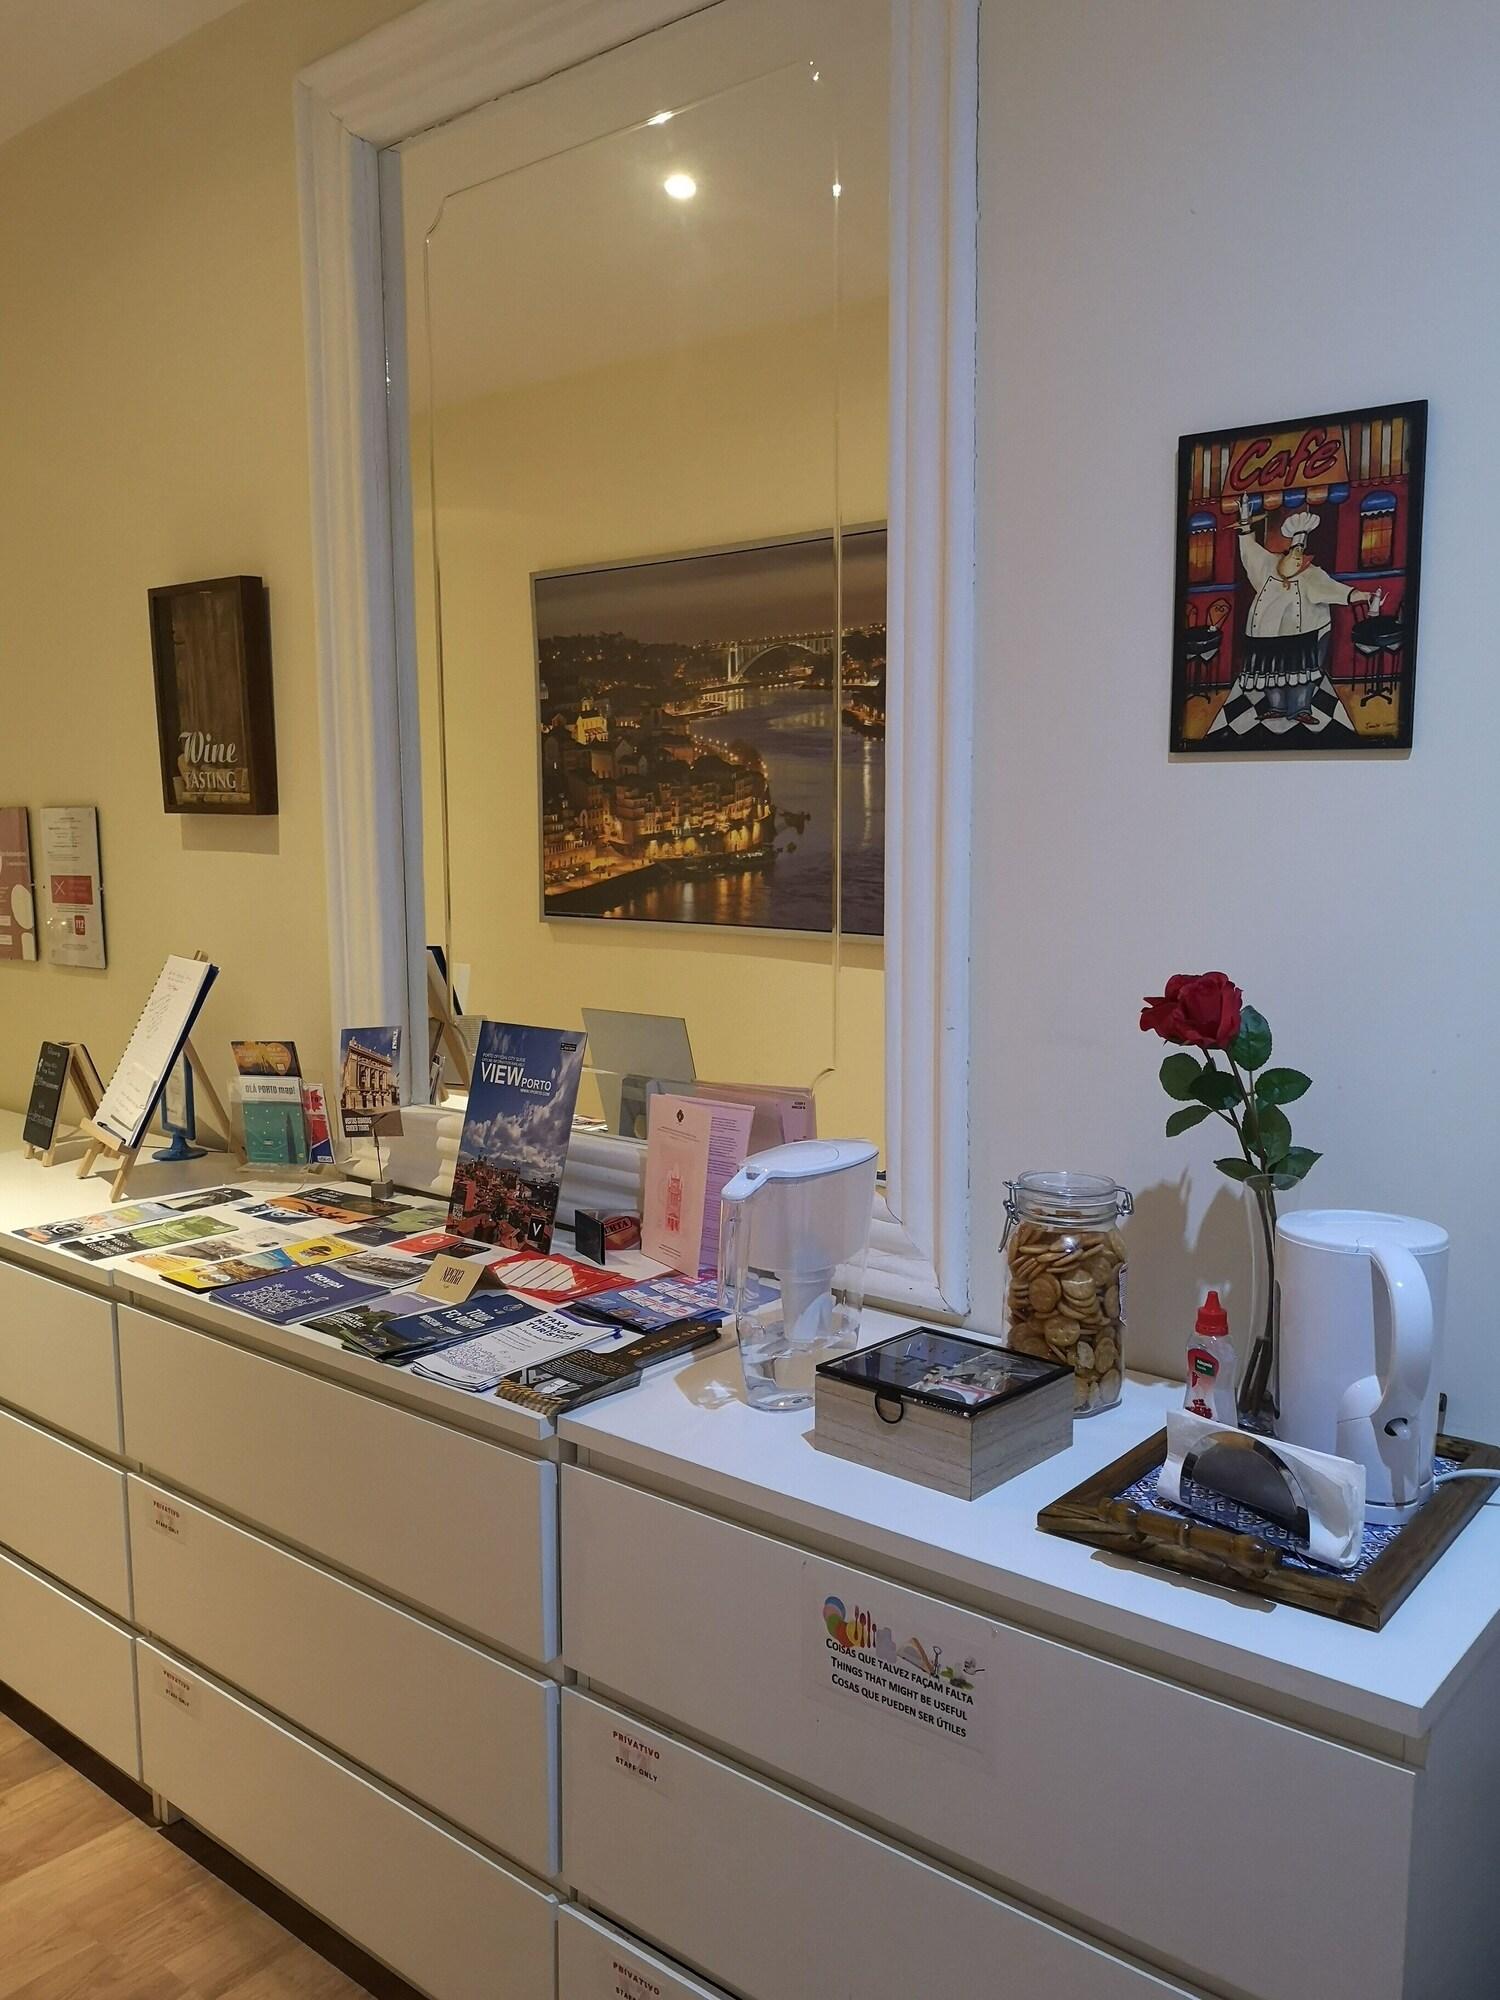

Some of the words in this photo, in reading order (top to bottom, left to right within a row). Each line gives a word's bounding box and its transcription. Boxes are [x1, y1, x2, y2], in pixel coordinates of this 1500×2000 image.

[178, 731, 238, 764] Wine
[185, 771, 237, 790] TASTING
[257, 1085, 277, 1095] PORTO
[534, 1222, 542, 1238] V
[534, 1319, 584, 1337] MUNICIPAL
[544, 1315, 569, 1329] TAXA
[825, 1638, 857, 1658] COISAS
[857, 1652, 877, 1667] QUE
[877, 1660, 910, 1680] TALVEZ
[911, 1673, 944, 1693] FAÇAM
[945, 1686, 974, 1705] FALTA
[831, 1656, 863, 1678] THINGS
[864, 1671, 886, 1688] THAT
[888, 1681, 919, 1701] MIGHT
[920, 1694, 932, 1706] BE
[933, 1700, 967, 1720] USEFUL
[831, 1673, 860, 1694] COSAS
[861, 1687, 880, 1701] QUE
[881, 1695, 917, 1717] PUEDEN
[918, 1710, 935, 1725] SER
[936, 1716, 967, 1738] ÚTILES
[612, 1730, 660, 1760] PRIVATIVO
[615, 1756, 637, 1771] STAFF
[638, 1768, 657, 1782] ONLY
[612, 1961, 660, 1995] PRIVATIVO
